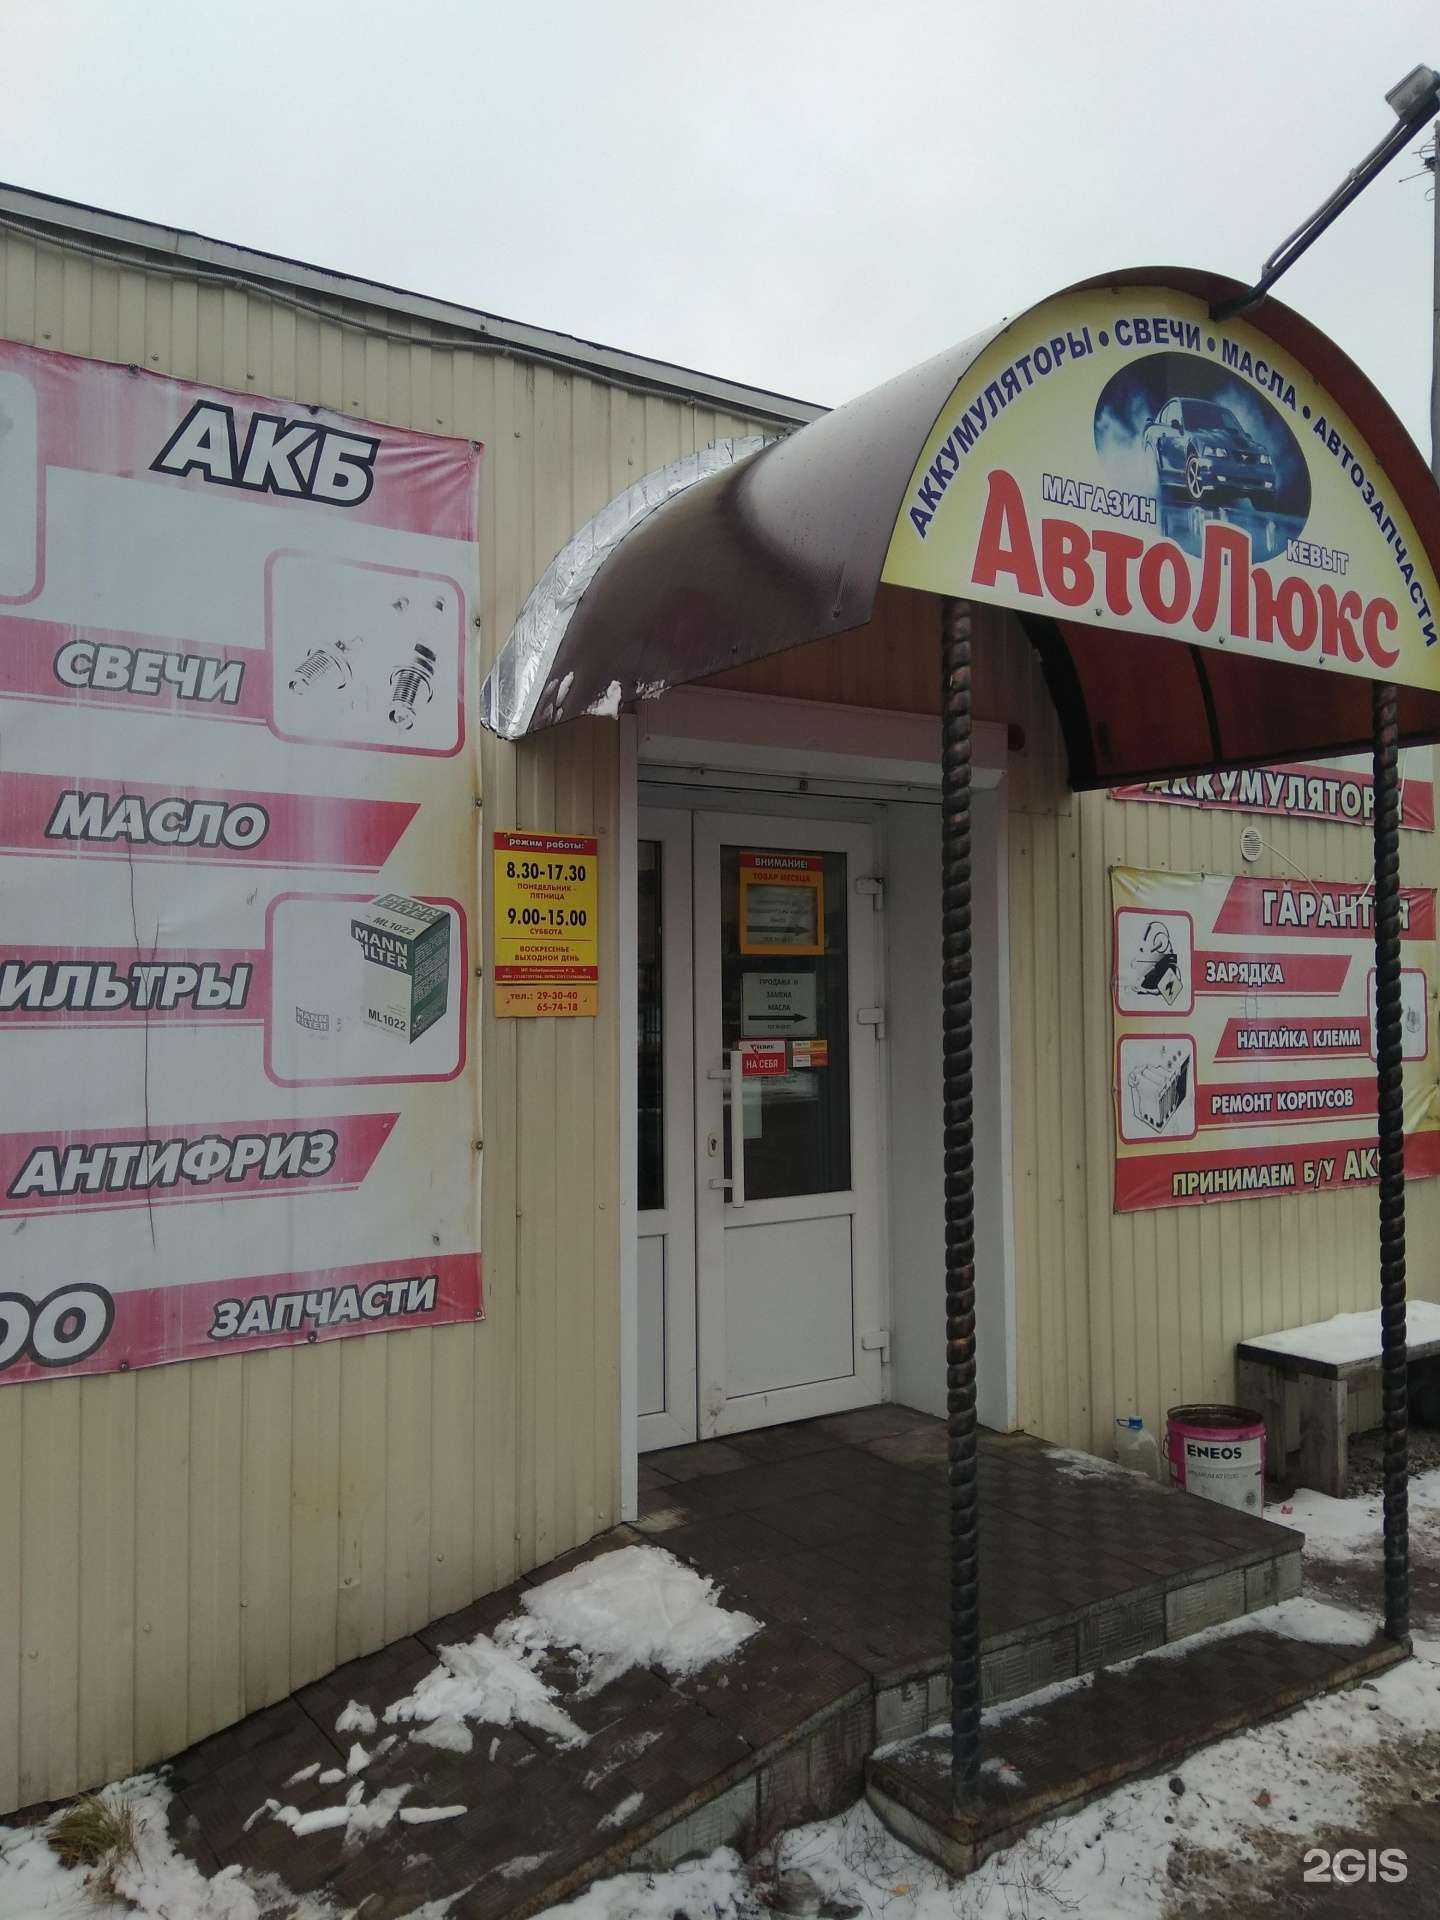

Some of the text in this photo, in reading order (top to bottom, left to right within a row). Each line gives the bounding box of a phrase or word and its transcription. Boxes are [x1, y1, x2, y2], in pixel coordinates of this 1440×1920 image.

[1113, 317, 1201, 347] СВЕЧИ
[1221, 341, 1298, 413] МАСЛА
[907, 325, 1094, 540] АККУМУЛЯТОРЫ
[149, 399, 382, 508] АКБ
[1041, 472, 1157, 525] МАГАЗИН
[1313, 416, 1438, 648] АВТОЗАПЧАСТИ
[1286, 538, 1350, 575] КЕВЫТ
[53, 639, 246, 704] СВЕЧИ
[1146, 768, 1403, 822] ККУМУЛЯТОР
[45, 790, 270, 850] МАСЛО
[506, 861, 587, 882] 8.30-17.30
[754, 857, 808, 869] ВНИМАНИЕ!
[517, 882, 571, 891] ПОНЕДЕЛЬНИК
[529, 892, 565, 900] ПЯТНИЦА
[507, 907, 587, 926] 9.00-15.00
[1262, 890, 1410, 932] ГАРАНТЯ
[389, 921, 416, 936] 1022
[354, 926, 408, 957] MANN
[519, 945, 570, 953] ВОСКРЕСЕНЬЕ
[561, 954, 579, 962] ДЕНЬ
[1205, 960, 1285, 985] ЗАРЯДКА
[536, 991, 578, 1000] 29-30-40
[536, 1002, 578, 1012] 65-74-18
[383, 1015, 407, 1032] 1022
[1236, 1028, 1361, 1050] НАПАЙКА КЛЕММ
[746, 1060, 778, 1069] НА СЕБЯ
[1211, 1091, 1354, 1114] РЕМОНТ КОРПУСОВ
[7, 1130, 338, 1199] АНТИФРИЗ
[1172, 1147, 1380, 1197] ПРИНИМАЕМ Б/У АК
[209, 1275, 438, 1342] ЗАПЧАСТИ
[1186, 1443, 1242, 1460] ENEOS
